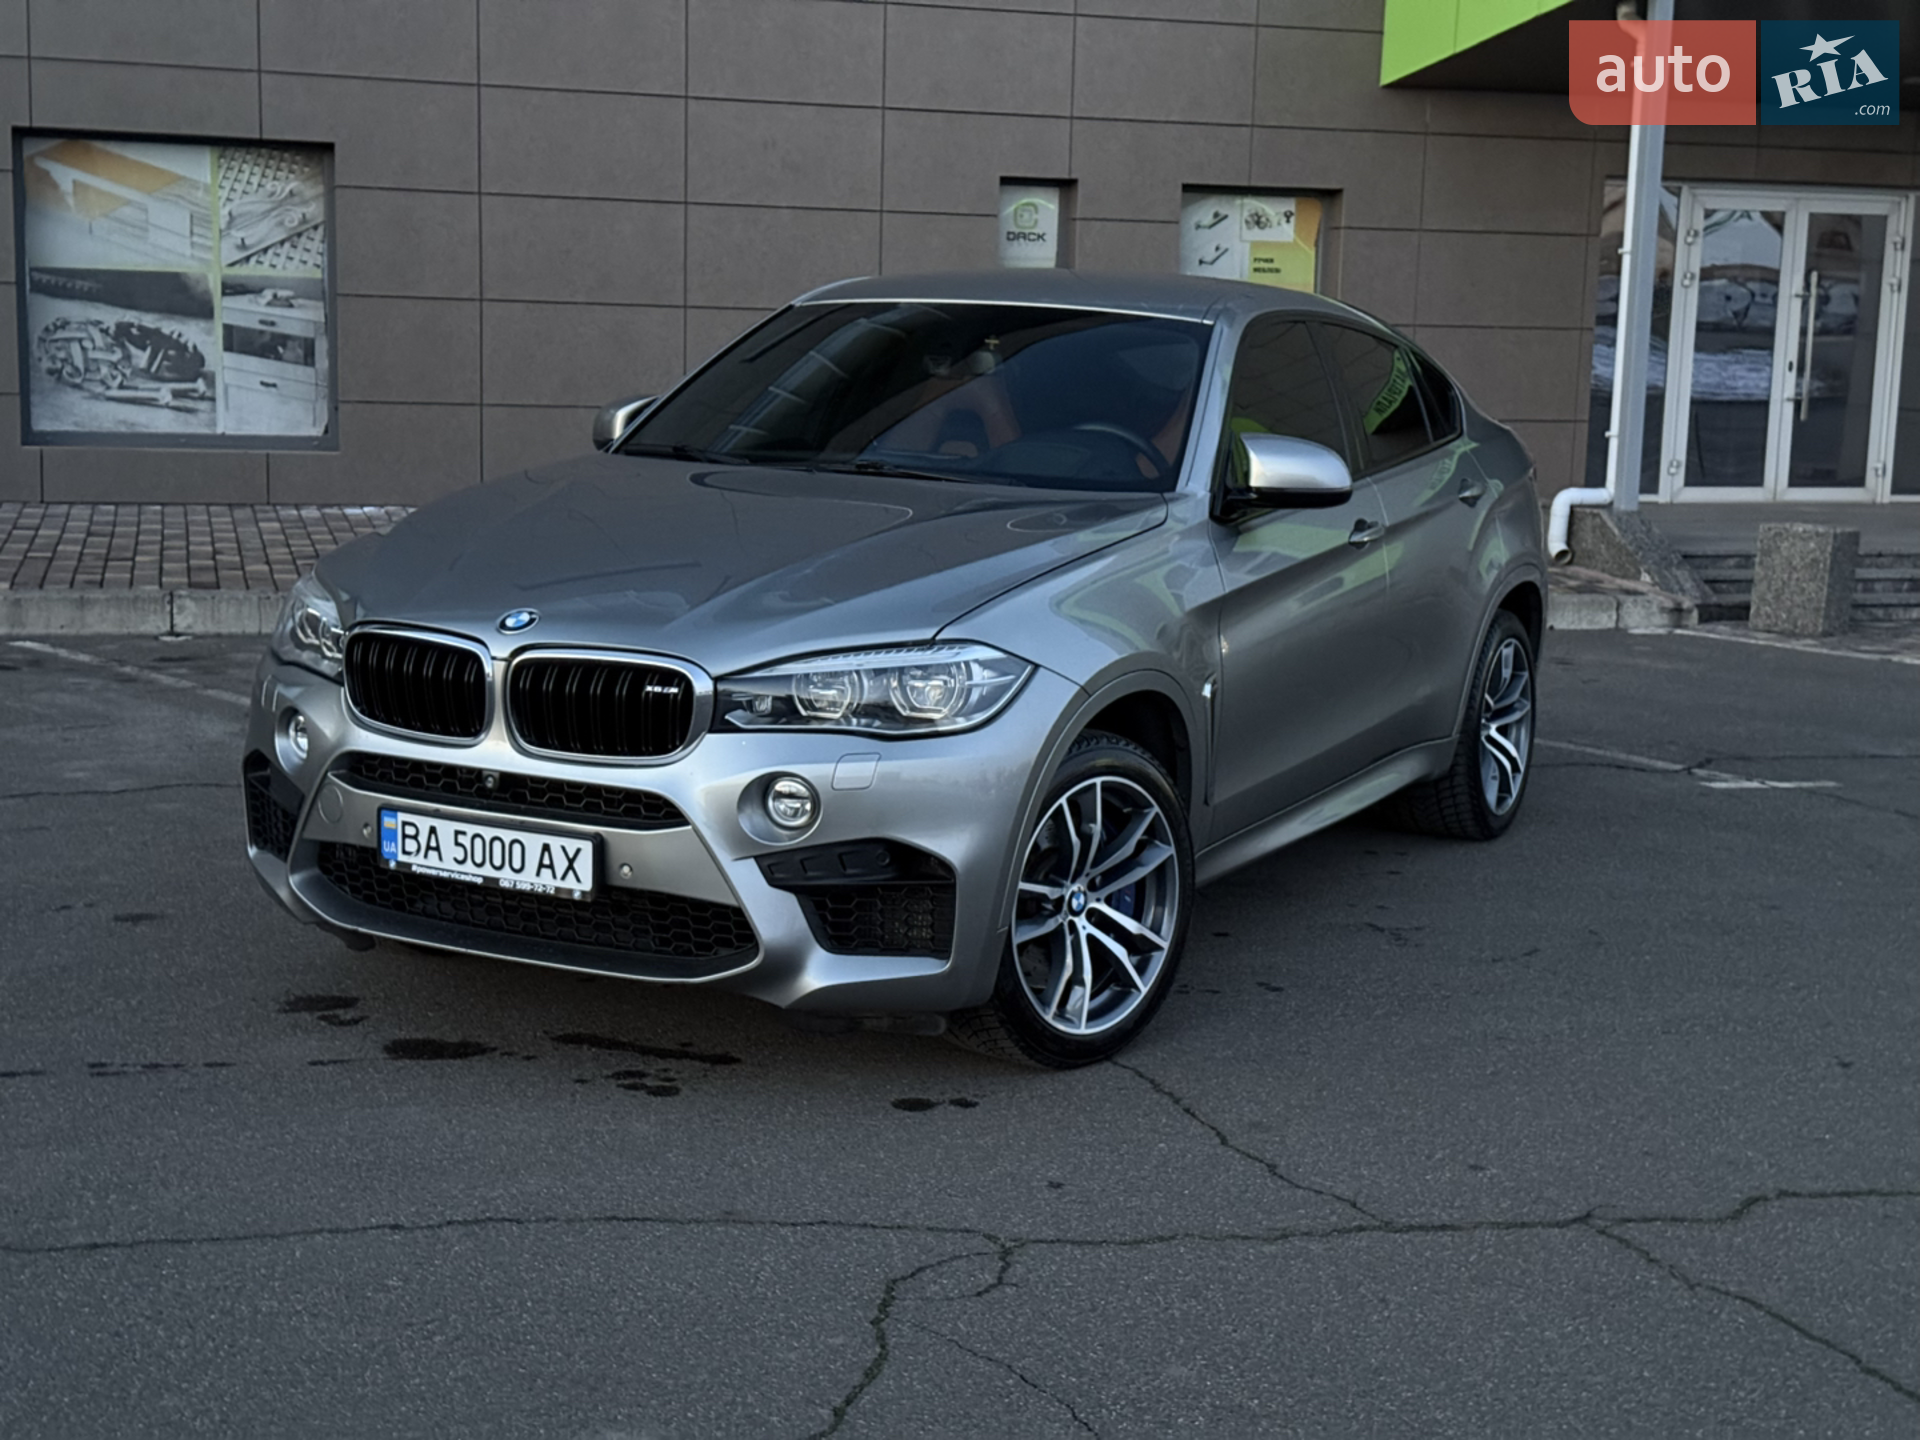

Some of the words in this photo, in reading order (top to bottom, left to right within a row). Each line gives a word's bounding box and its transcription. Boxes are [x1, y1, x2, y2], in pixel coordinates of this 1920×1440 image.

[383, 840, 397, 853] UA
[401, 820, 444, 862] BA
[452, 829, 526, 874] 5000
[535, 842, 582, 884] AX
